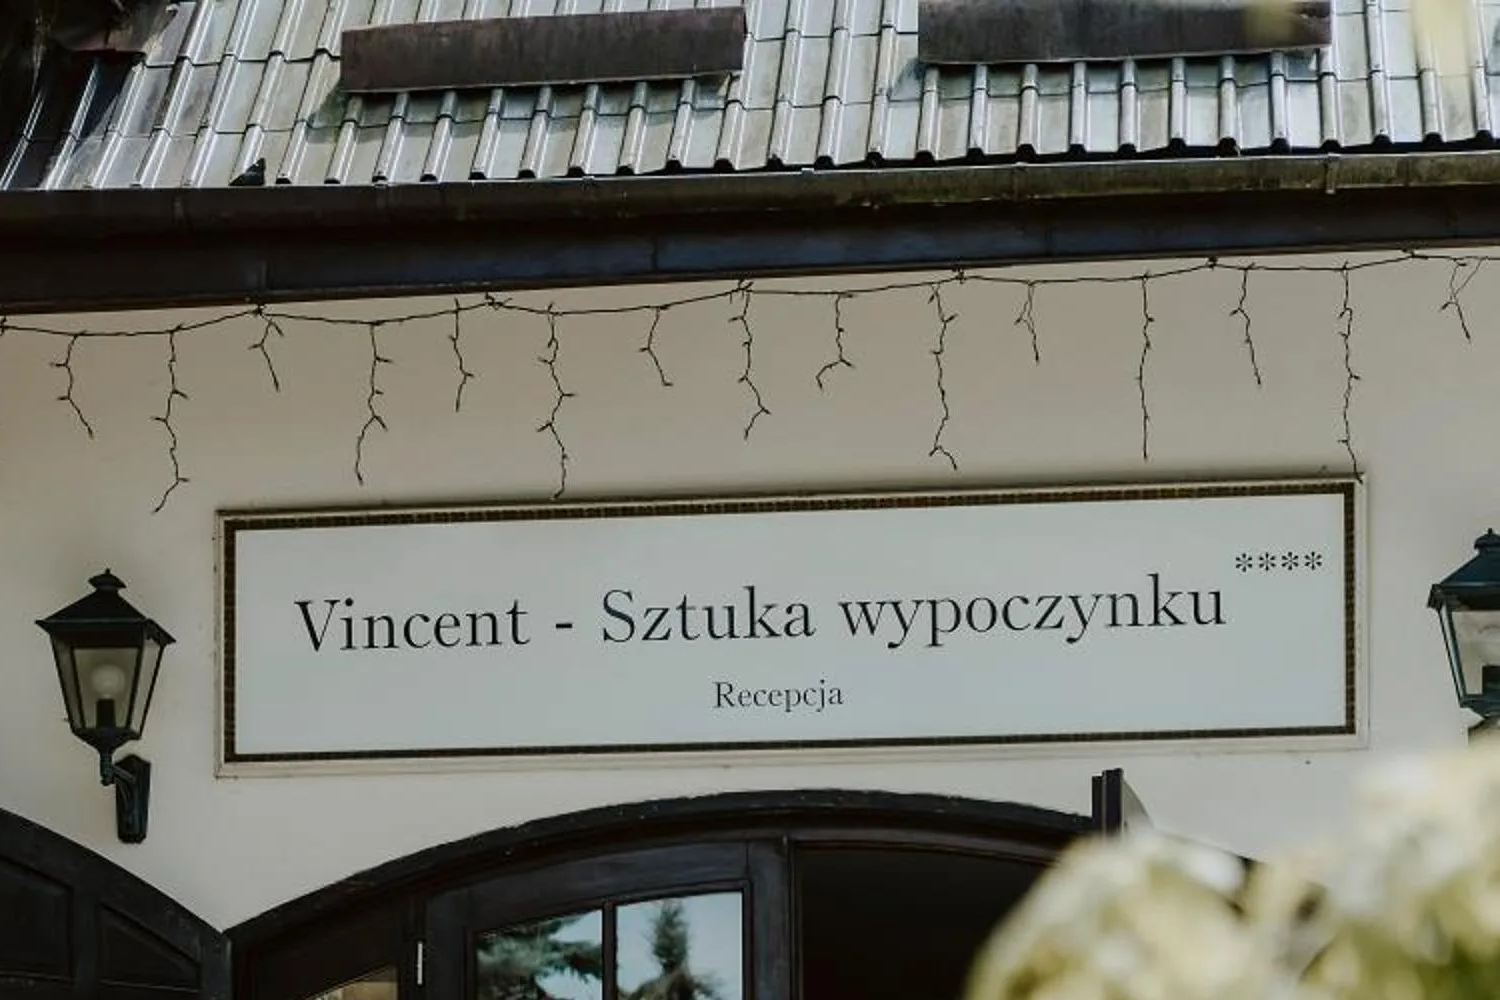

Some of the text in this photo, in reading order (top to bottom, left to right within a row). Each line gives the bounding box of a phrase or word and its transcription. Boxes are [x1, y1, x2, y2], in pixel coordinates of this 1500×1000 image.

[293, 597, 531, 653] Vincent
[602, 584, 817, 643] Sztuka
[837, 572, 1227, 650] wypoczynku
[713, 678, 844, 713] Recepcja
